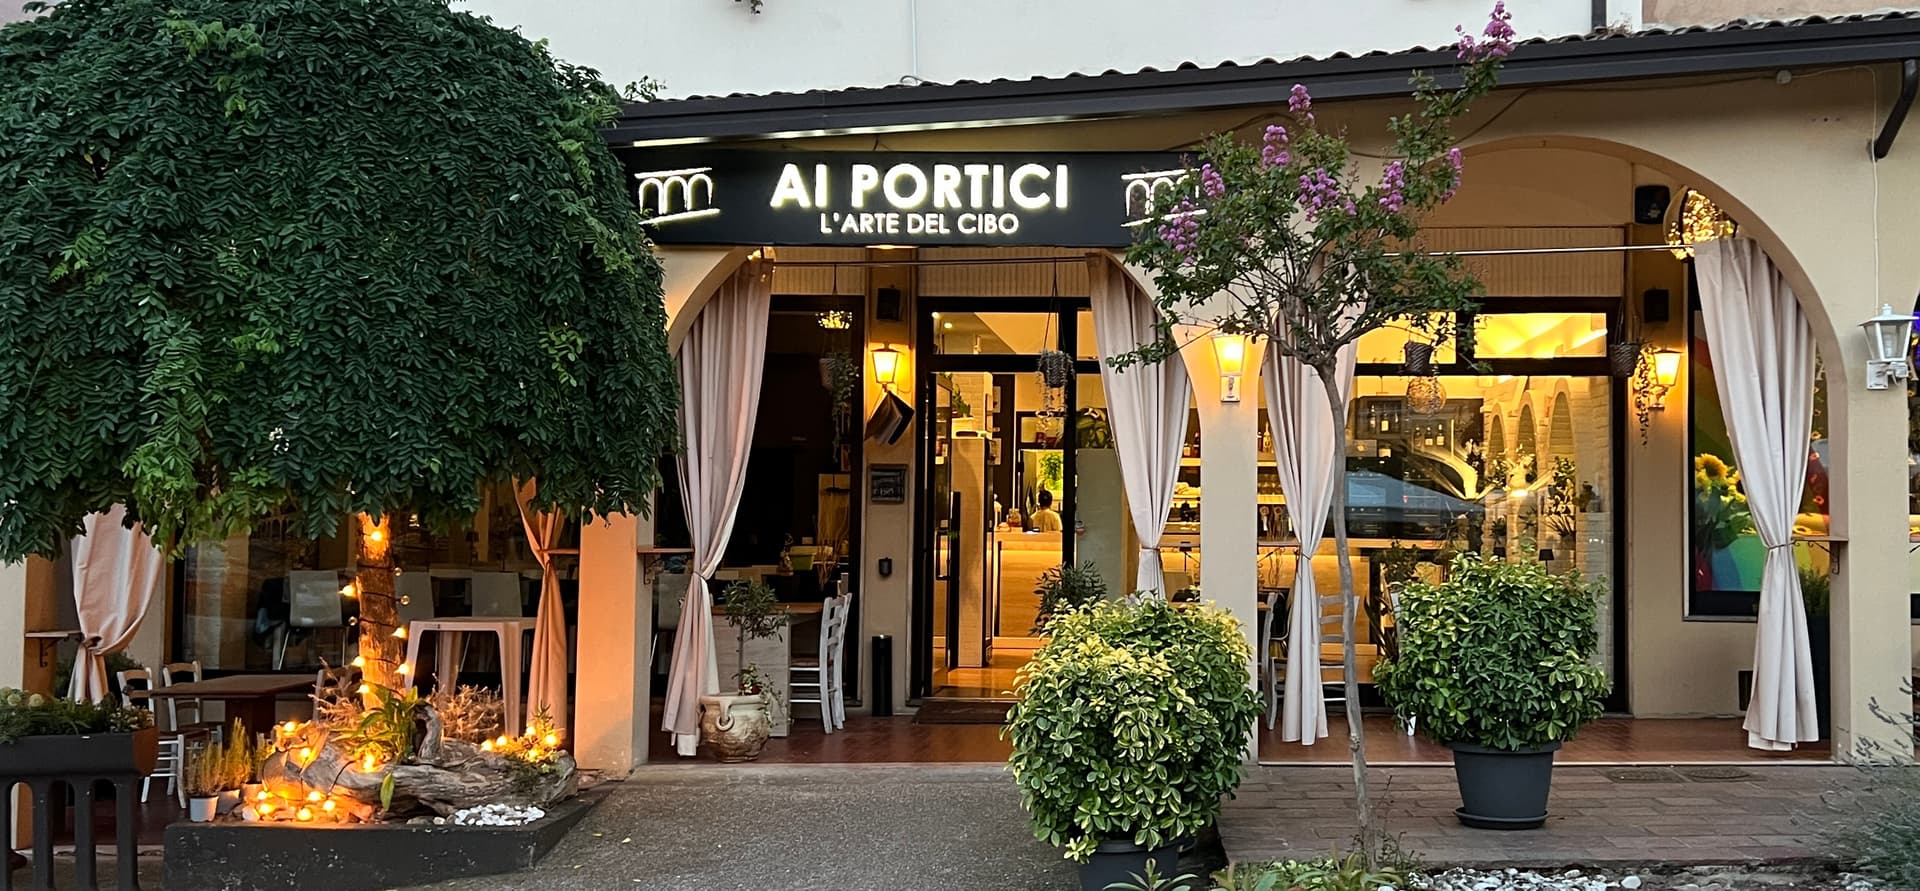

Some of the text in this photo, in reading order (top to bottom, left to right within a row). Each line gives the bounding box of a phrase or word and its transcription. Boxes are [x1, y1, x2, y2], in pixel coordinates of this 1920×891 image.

[769, 162, 1069, 209] AI PORTICI
[820, 212, 1020, 235] L'ARTE DEL CIBO
